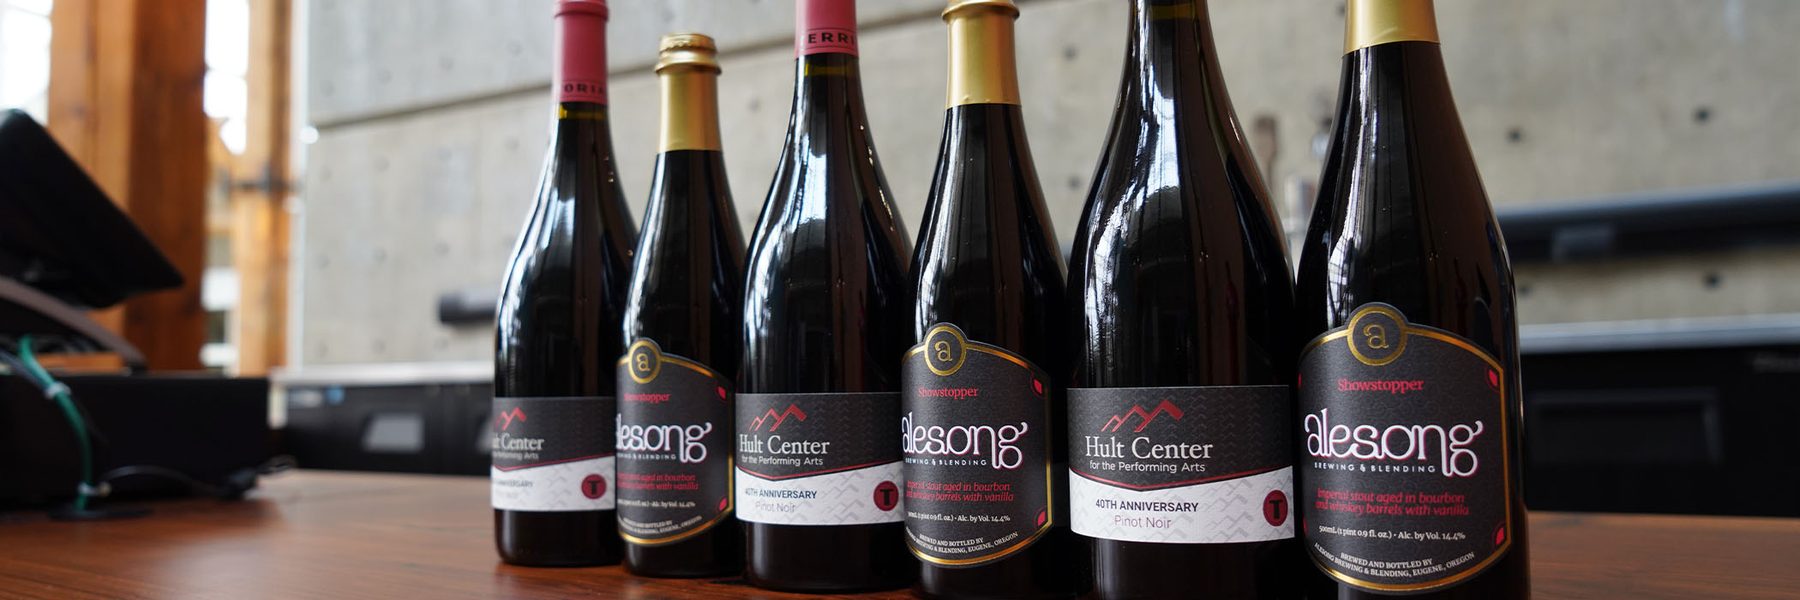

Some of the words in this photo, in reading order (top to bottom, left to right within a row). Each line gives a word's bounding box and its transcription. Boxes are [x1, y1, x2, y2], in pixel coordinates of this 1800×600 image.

[1363, 324, 1389, 348] a
[935, 341, 952, 361] a
[919, 387, 978, 399] Showstopper
[1338, 379, 1424, 394] Showstopper
[501, 432, 545, 450] Center
[739, 434, 763, 453] Hult
[767, 435, 830, 454] Center
[901, 412, 1028, 469] alesong
[1085, 436, 1125, 458] Hult
[1131, 437, 1213, 459] Center
[1304, 407, 1484, 477] alesong
[759, 456, 800, 466] Performing
[804, 457, 823, 465] Arts
[1090, 461, 1100, 470] for
[1102, 461, 1116, 471] the
[1119, 461, 1177, 474] Performing
[1181, 463, 1206, 472] Arts
[1314, 462, 1354, 472] BREWING
[1371, 463, 1436, 472] BLENDING
[588, 481, 600, 495] T
[760, 489, 817, 499] ANNIVERSARY
[964, 482, 971, 491] in
[974, 482, 1010, 491] bourbon
[880, 489, 893, 506] T
[963, 492, 983, 501] with
[985, 492, 1014, 501] vanilla
[1350, 490, 1374, 502] stout
[1376, 492, 1402, 504] aged
[1406, 492, 1416, 502] in
[1419, 492, 1465, 503] bourbon
[1095, 499, 1117, 510] 40TH
[1120, 501, 1199, 512] ANNIVERSARY
[1269, 500, 1283, 520] T
[1330, 501, 1363, 515] whiskey
[1366, 503, 1402, 514] barrels
[1406, 504, 1431, 515] with
[1433, 504, 1470, 516] vanilla
[970, 514, 978, 523] by
[1114, 515, 1142, 528] Pinot
[1146, 516, 1171, 528] Noir
[975, 537, 984, 545] BY
[994, 531, 1018, 546] OREGON
[1343, 526, 1356, 537] pint
[1357, 529, 1368, 537] 0.9
[1369, 528, 1377, 538] fl.
[1377, 530, 1392, 539] oz.)
[1398, 531, 1413, 540] Alc.
[1414, 531, 1425, 541] by
[1426, 532, 1441, 540] Vol.
[1442, 532, 1466, 541] 14.4%
[1334, 556, 1364, 573] BREWING
[1370, 567, 1412, 577] BLENDING,
[1412, 563, 1447, 576] EUGENE,
[1446, 551, 1475, 568] OREGON
[1340, 552, 1368, 566] BREWED
[1369, 560, 1385, 568] AND
[1386, 560, 1420, 569] BOTTLED
[1421, 558, 1433, 566] BY
